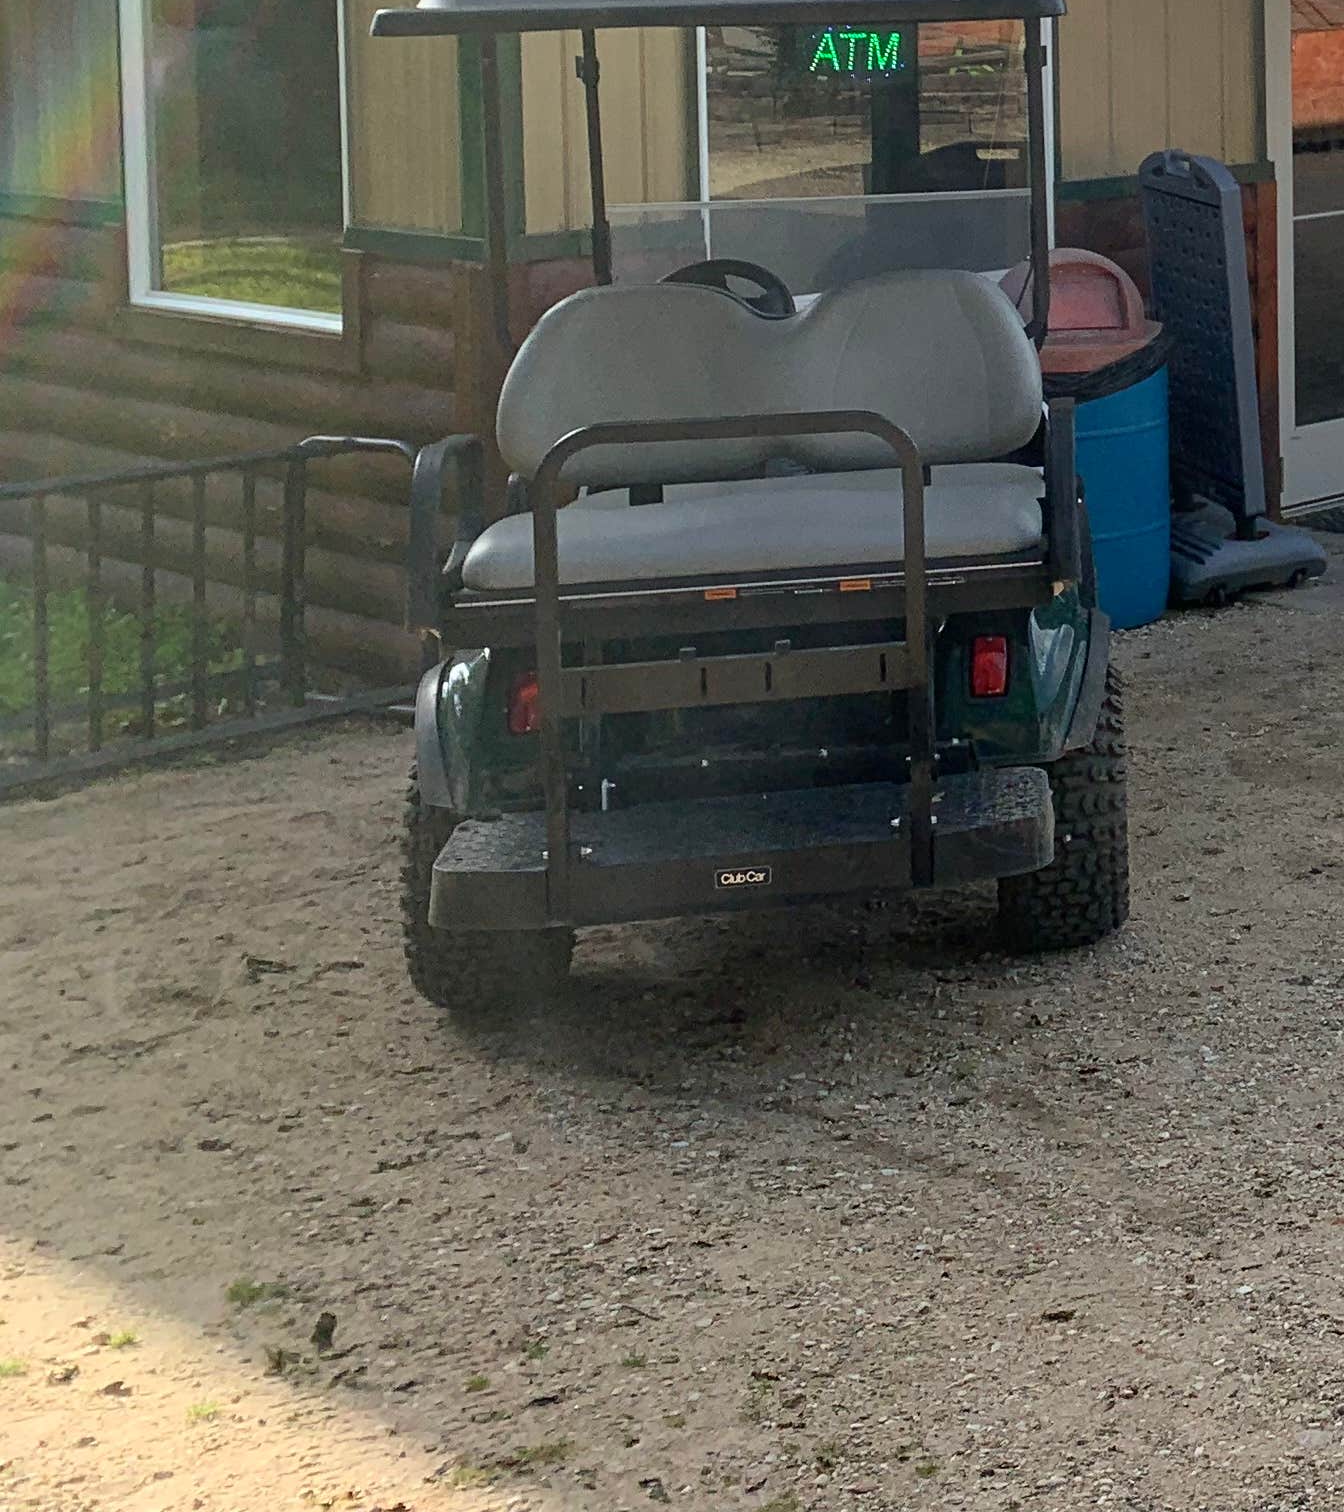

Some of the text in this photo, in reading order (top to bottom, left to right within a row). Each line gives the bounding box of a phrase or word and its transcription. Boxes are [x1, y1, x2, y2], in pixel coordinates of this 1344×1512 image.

[809, 33, 901, 72] ATM
[720, 870, 767, 885] Club Car
